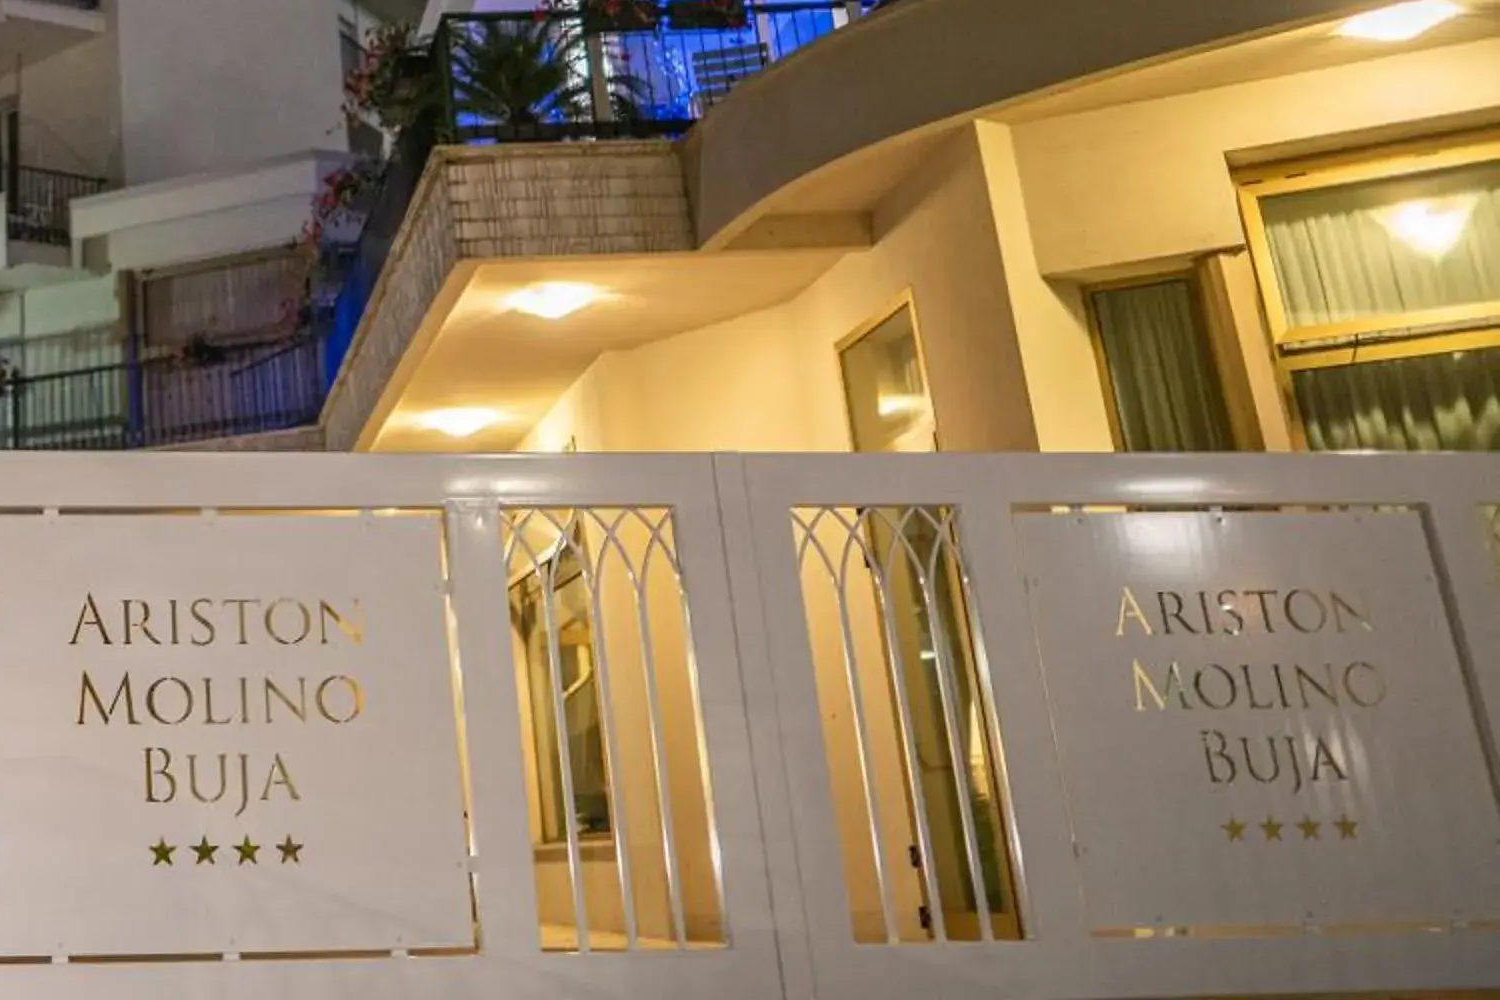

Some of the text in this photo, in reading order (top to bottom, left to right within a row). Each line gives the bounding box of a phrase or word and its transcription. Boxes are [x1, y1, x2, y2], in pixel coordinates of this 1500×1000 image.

[67, 592, 364, 646] ARISTON
[1115, 586, 1373, 636] ARISTON
[76, 670, 365, 725] MOLINO
[1132, 658, 1387, 712] MOLINO
[143, 747, 301, 817] BUJA
[1199, 728, 1349, 794] BUJA
